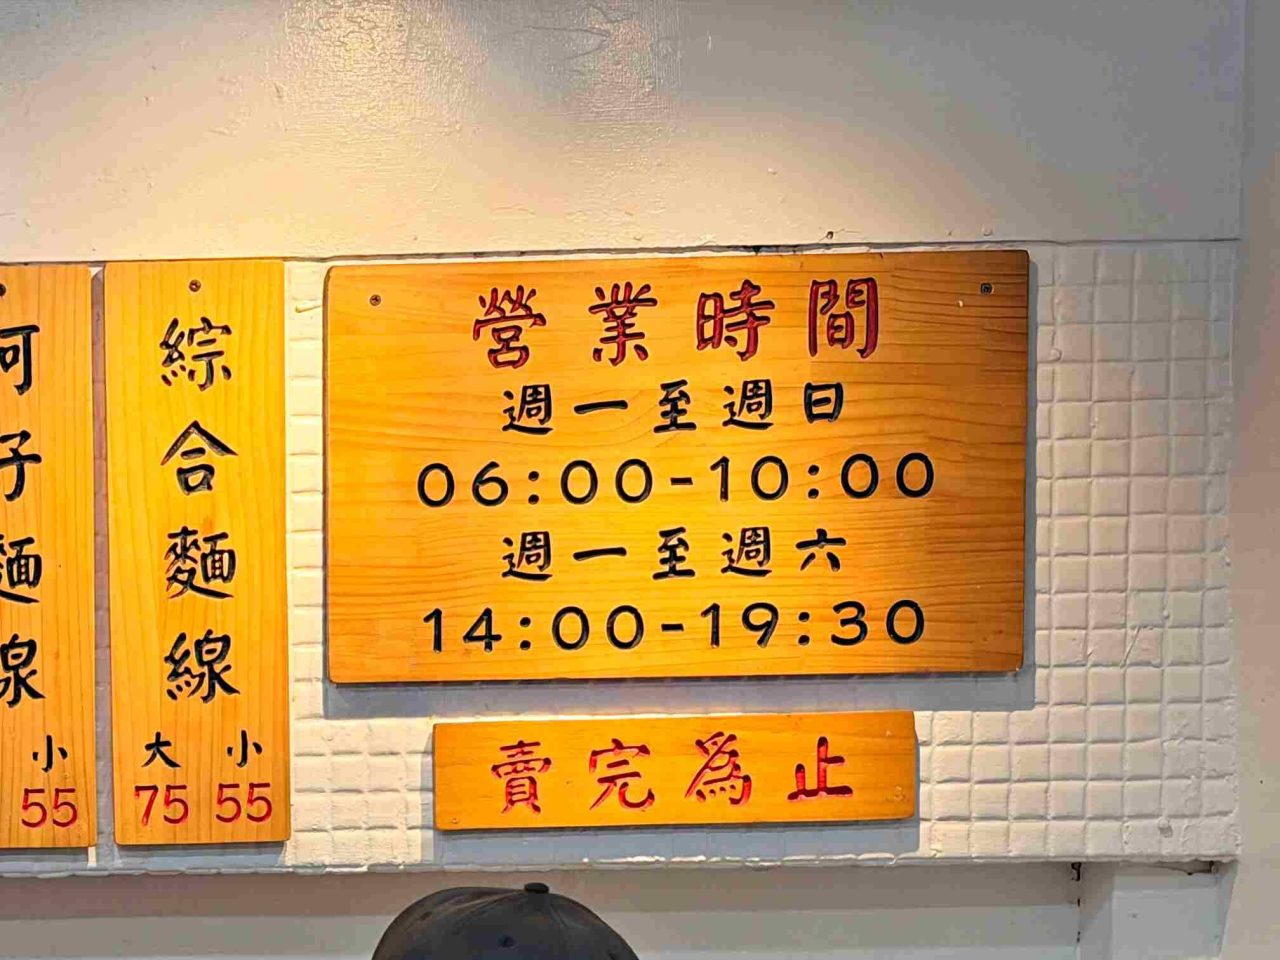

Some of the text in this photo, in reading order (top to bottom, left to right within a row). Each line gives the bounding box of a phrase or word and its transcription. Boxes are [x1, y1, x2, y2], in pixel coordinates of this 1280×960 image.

[472, 277, 881, 369] 營業時間
[501, 379, 844, 434] 週一至週日
[417, 451, 935, 508] 06:00-10:00
[159, 316, 240, 704] 綜合麵線
[501, 526, 848, 582] 週一至週六
[422, 599, 926, 654] 14:00-19:30
[32, 734, 68, 773] 小
[144, 730, 263, 768] 大 小
[21, 786, 78, 828] 55
[133, 782, 273, 826] 75 55
